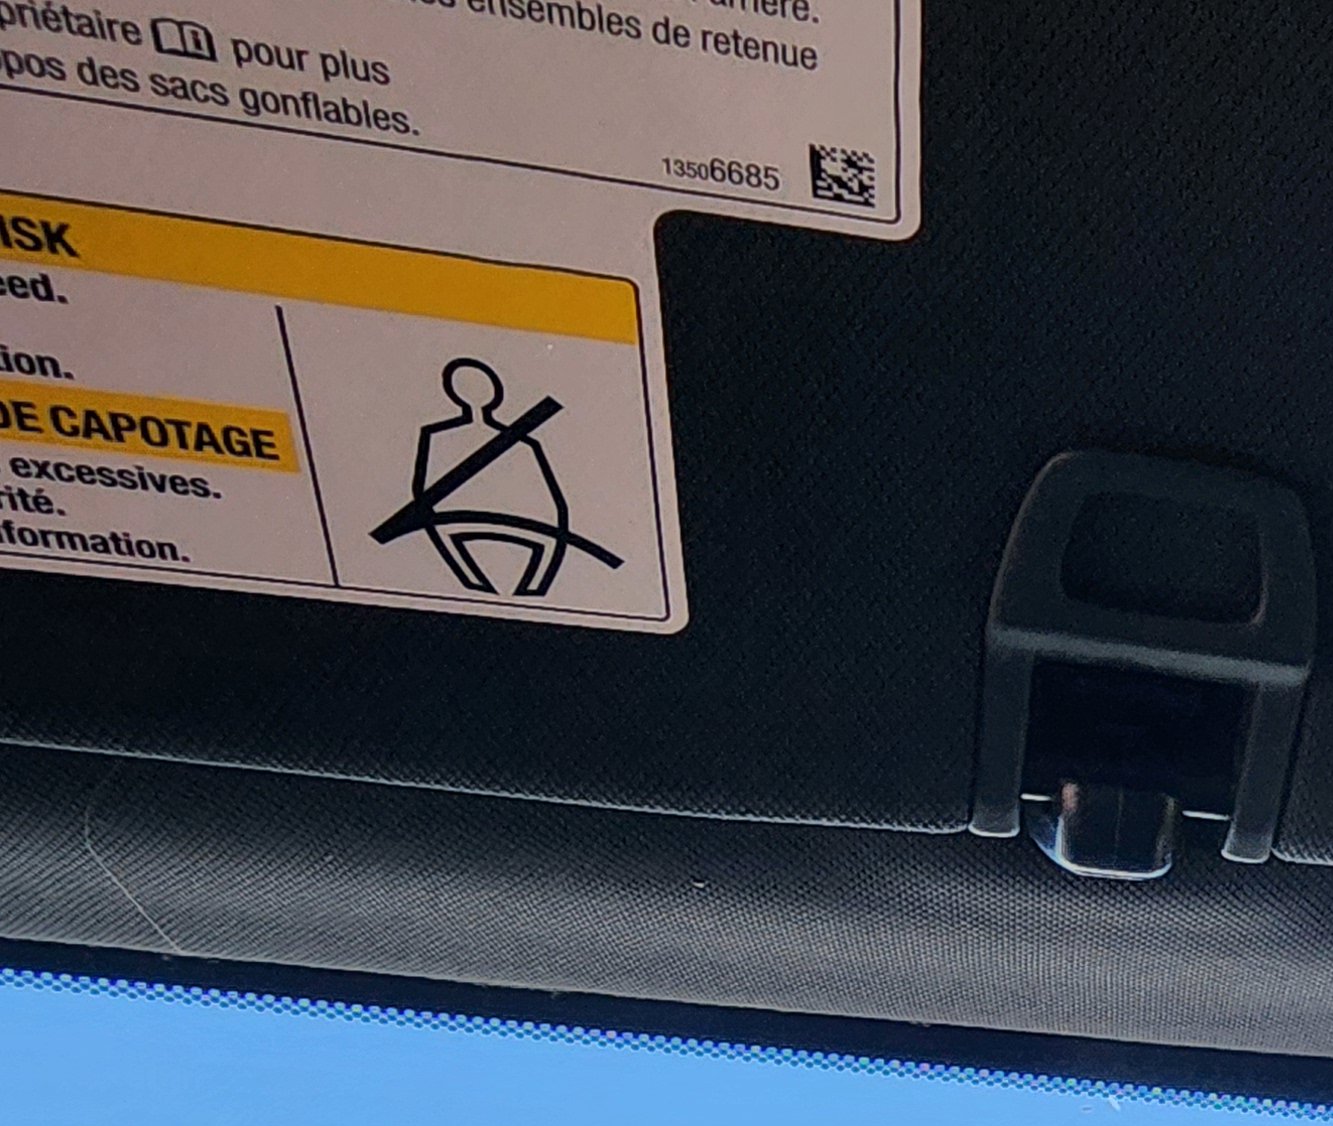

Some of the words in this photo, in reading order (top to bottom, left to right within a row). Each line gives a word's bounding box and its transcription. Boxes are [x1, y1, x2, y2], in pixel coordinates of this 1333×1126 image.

[467, 0, 642, 40] ensembles
[652, 16, 692, 48] de
[701, 29, 818, 71] retenue
[231, 38, 310, 72] pour
[319, 48, 391, 86] plus
[77, 56, 140, 93] des
[149, 73, 230, 106] sacs
[238, 87, 420, 136] gonflables.
[662, 157, 780, 191] 13506685
[49, 404, 280, 461] CAPOTAGE
[8, 456, 222, 500] excessives.
[0, 519, 191, 562] formation.
